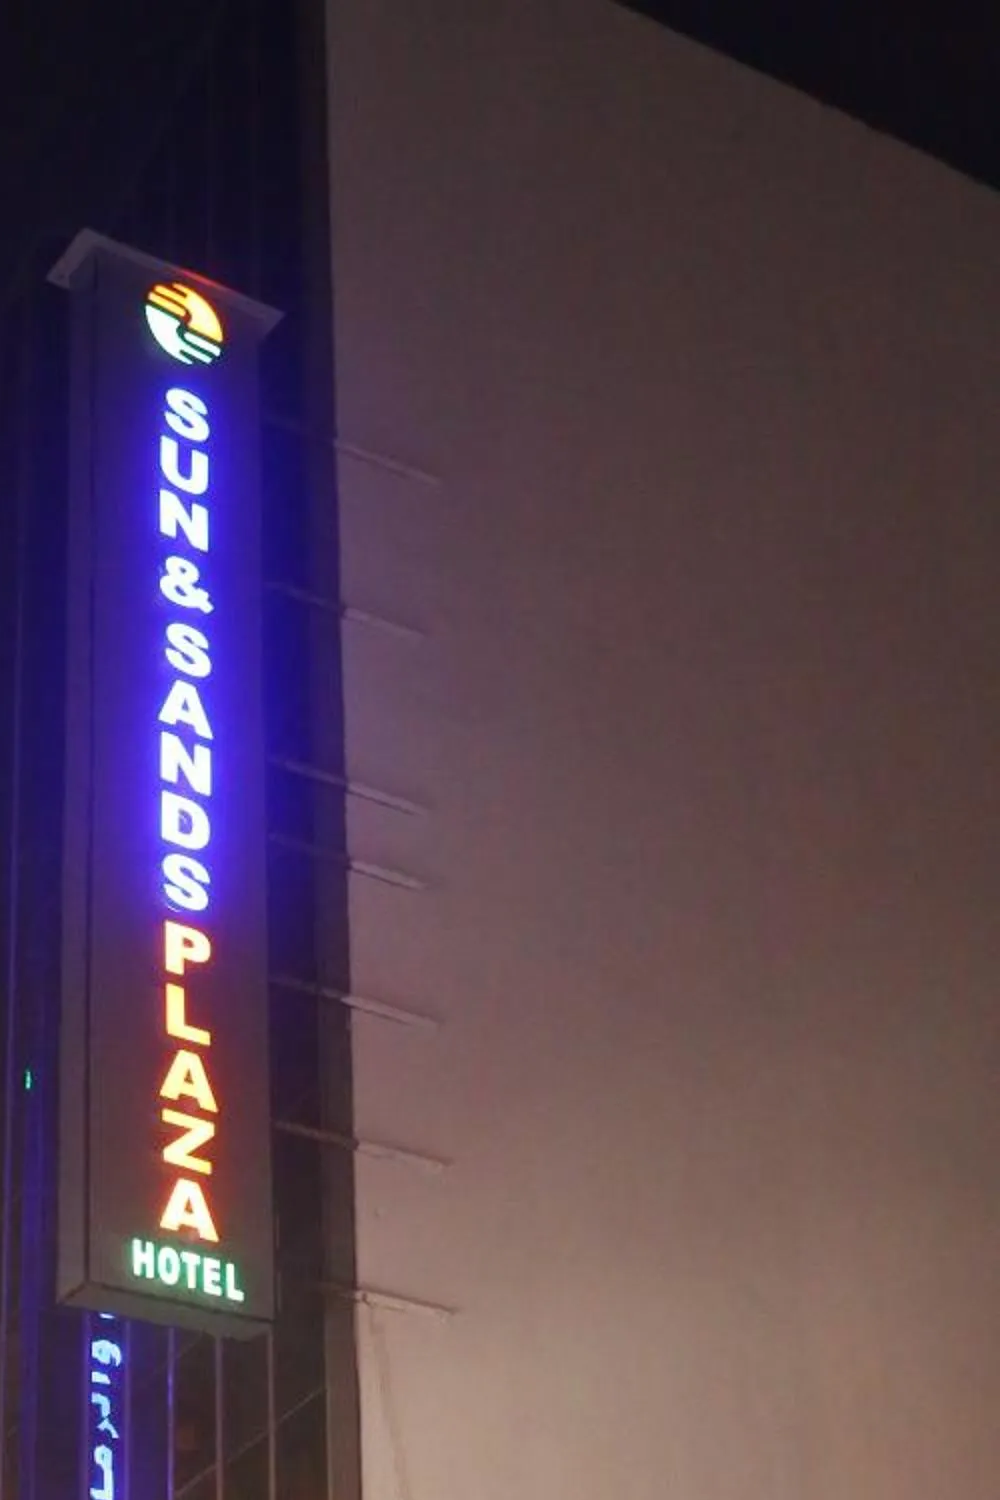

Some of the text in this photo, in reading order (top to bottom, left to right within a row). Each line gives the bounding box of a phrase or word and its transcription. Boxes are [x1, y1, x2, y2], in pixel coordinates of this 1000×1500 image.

[158, 387, 219, 1243] SUN & SANDS PLAZA
[131, 1238, 244, 1302] HOTEL
